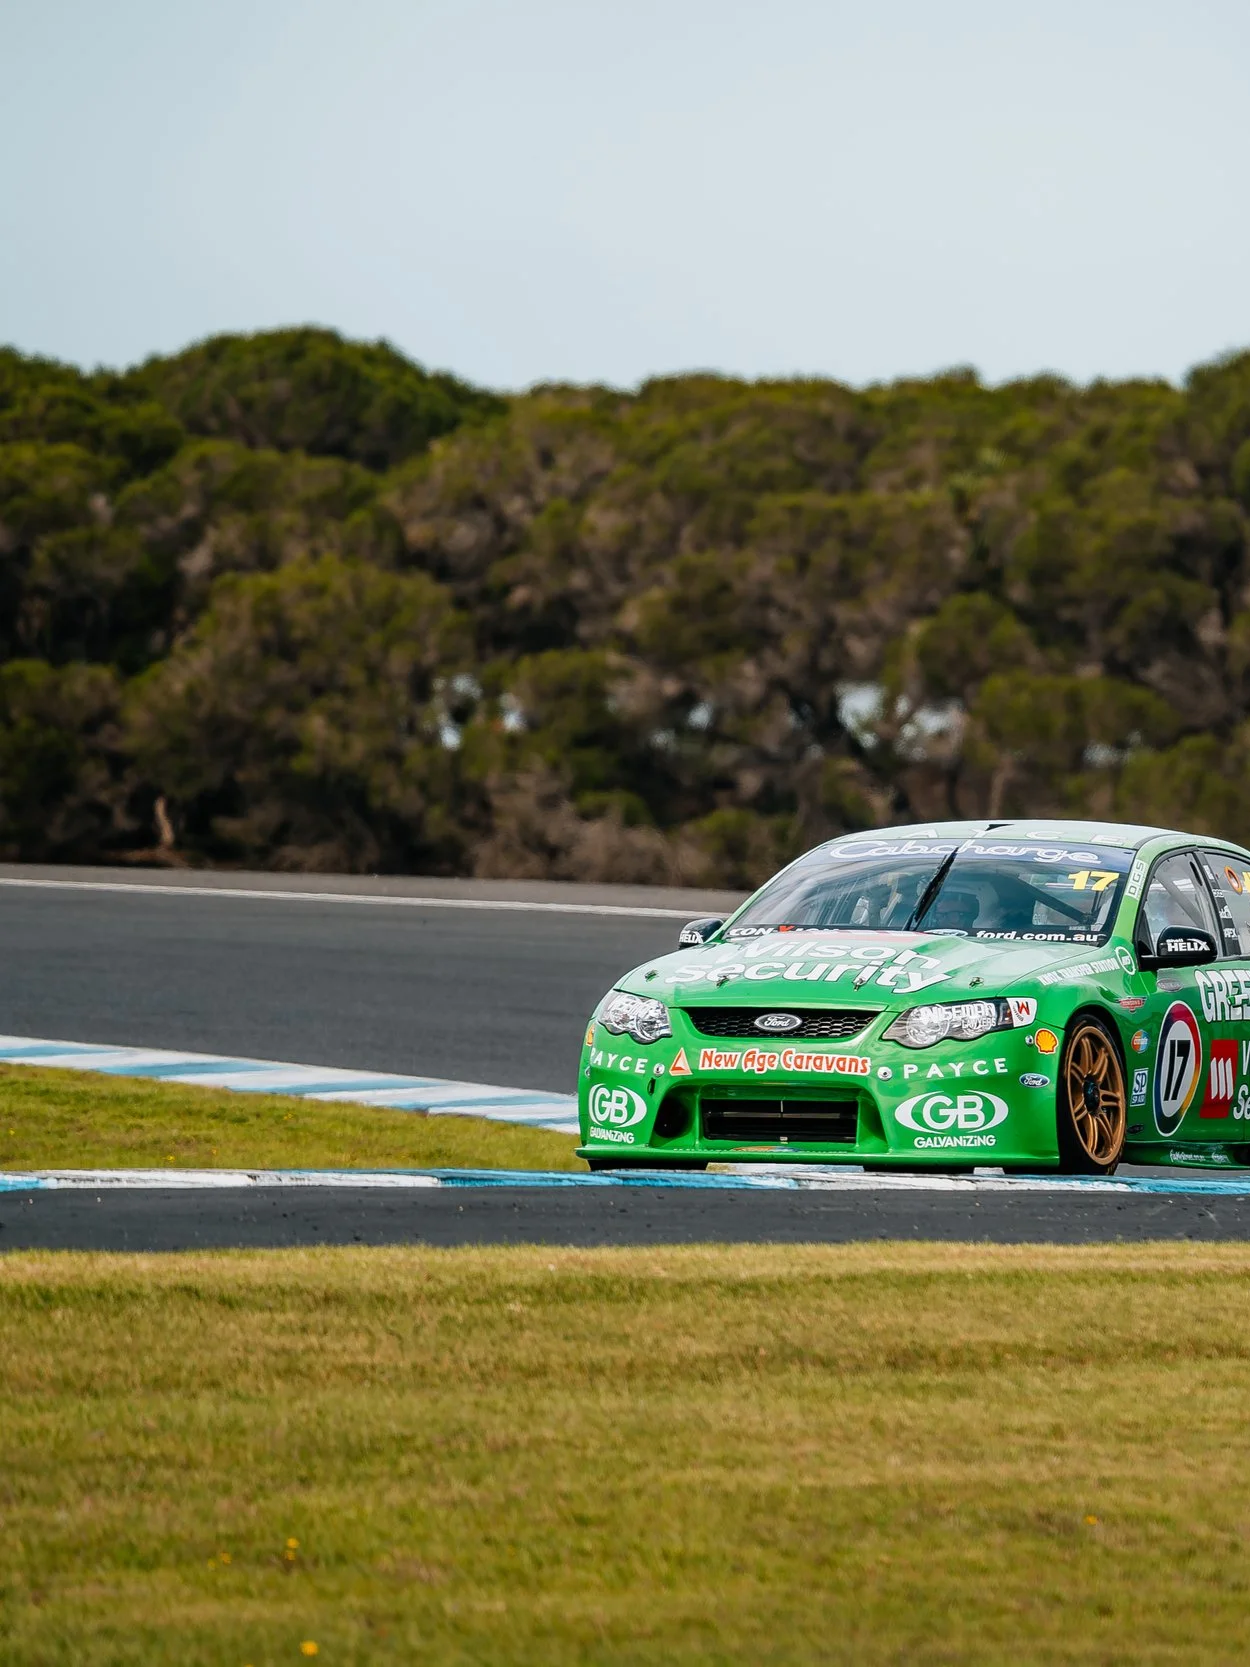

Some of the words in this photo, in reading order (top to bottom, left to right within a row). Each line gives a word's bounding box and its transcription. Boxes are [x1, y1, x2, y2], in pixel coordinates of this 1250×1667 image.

[829, 839, 1101, 865] Cabcharge
[1068, 870, 1120, 892] 17
[679, 932, 704, 944] HELIX
[976, 930, 1098, 943] ford.com.au
[1167, 941, 1210, 952] HELIX
[716, 940, 948, 970] Wilson
[665, 961, 952, 995] Security
[763, 1014, 793, 1028] Ford
[701, 1051, 738, 1069] New
[744, 1051, 778, 1073] Age
[783, 1050, 869, 1075] Caravans
[903, 1058, 1008, 1079] PAYCE
[1163, 1039, 1191, 1102] 17
[1022, 1074, 1046, 1087] Ford
[1134, 1072, 1147, 1094] SP
[594, 1087, 629, 1124] GB
[922, 1095, 985, 1130] GB
